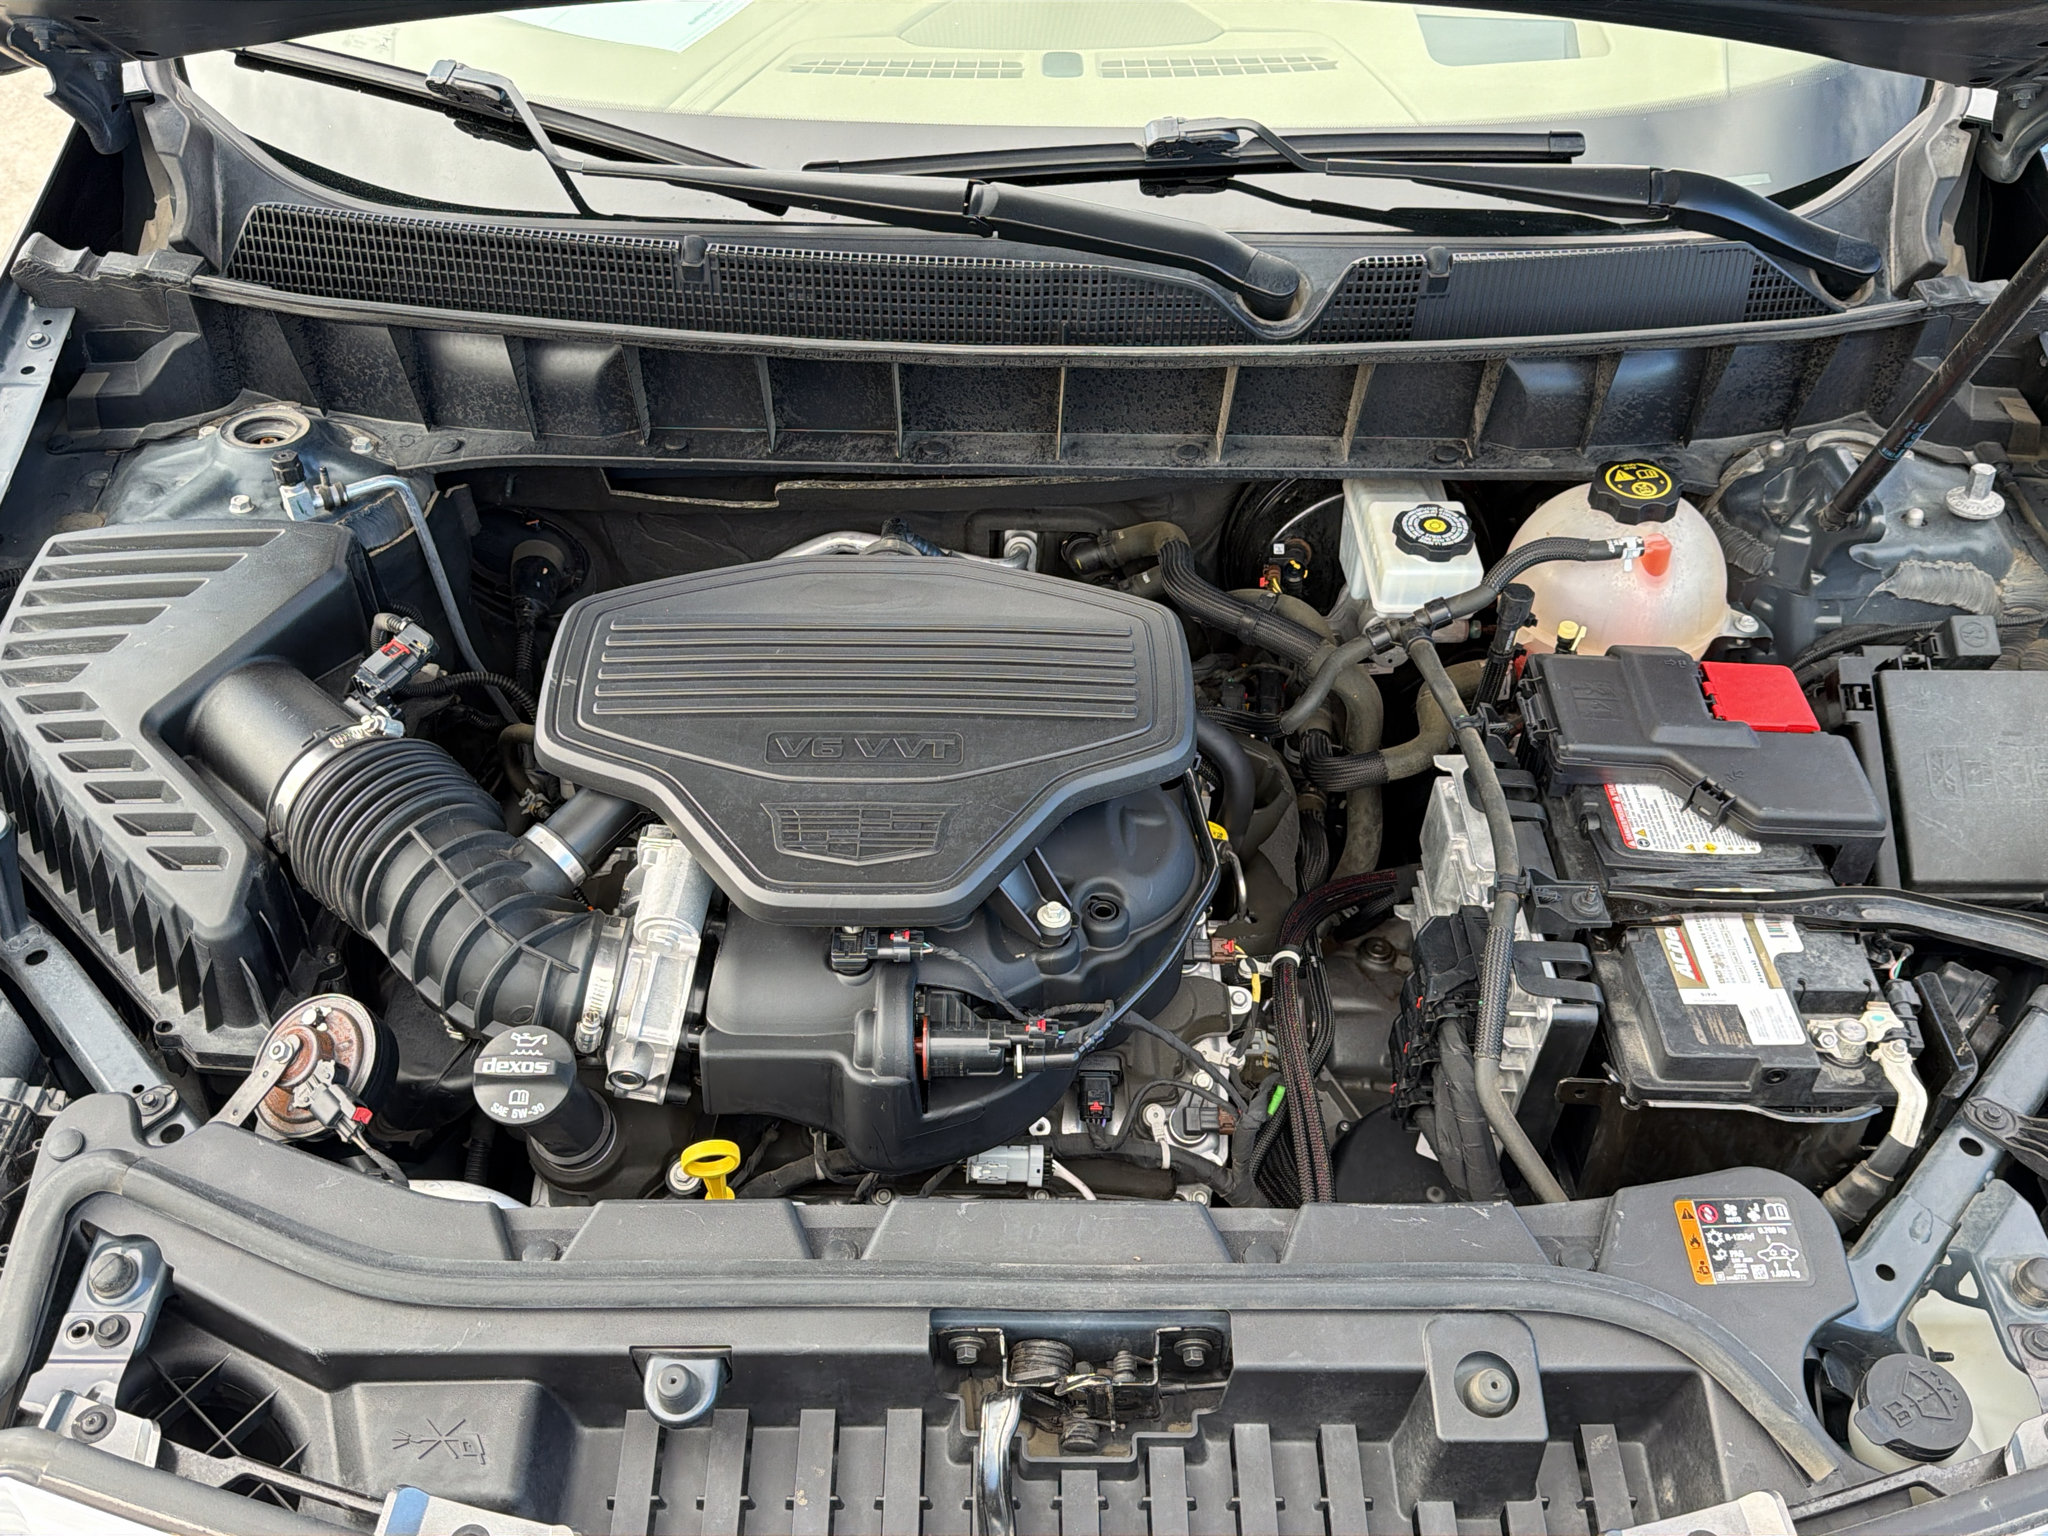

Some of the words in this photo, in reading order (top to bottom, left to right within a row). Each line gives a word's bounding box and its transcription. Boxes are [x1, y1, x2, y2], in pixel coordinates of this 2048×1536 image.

[775, 737, 844, 758] V6
[854, 737, 955, 759] VVT
[1664, 926, 1697, 980] ACDe
[481, 1057, 551, 1074] dexos
[490, 1102, 509, 1117] SAE
